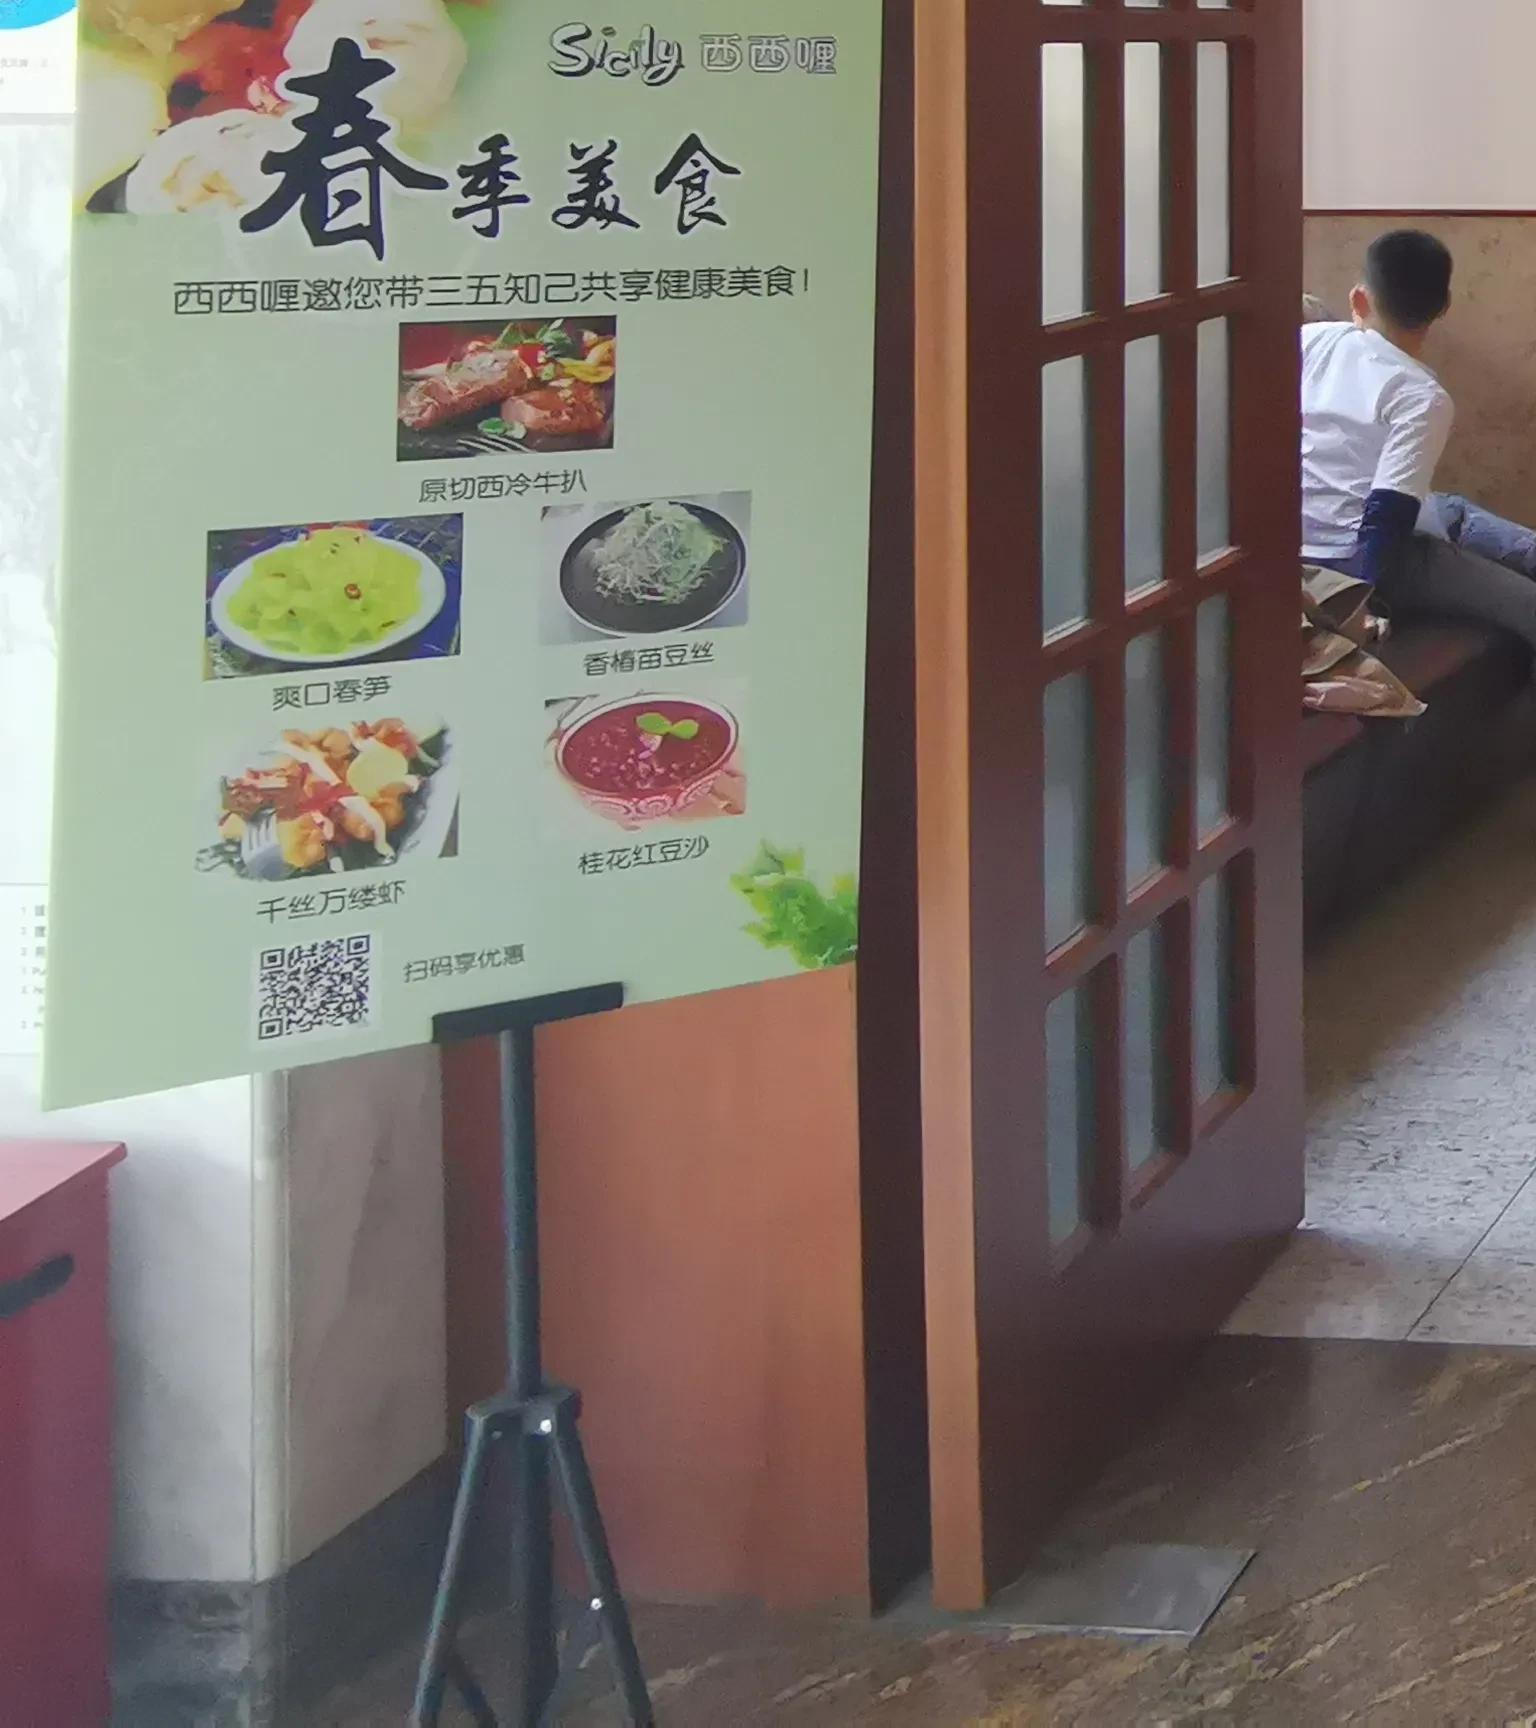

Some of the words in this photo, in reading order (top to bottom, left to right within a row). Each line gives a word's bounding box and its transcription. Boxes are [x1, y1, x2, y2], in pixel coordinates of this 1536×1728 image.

[548, 23, 685, 85] Sicily
[700, 32, 840, 76] 西西喱
[418, 469, 587, 505] 原切西冷牛扒
[583, 642, 715, 676] 香椿苗豆丝
[272, 675, 392, 711] 爽口春笋
[578, 836, 710, 876] 桂花红豆沙
[256, 879, 407, 925] 千丝万缕虾
[403, 943, 527, 984] 扫码享优惠
